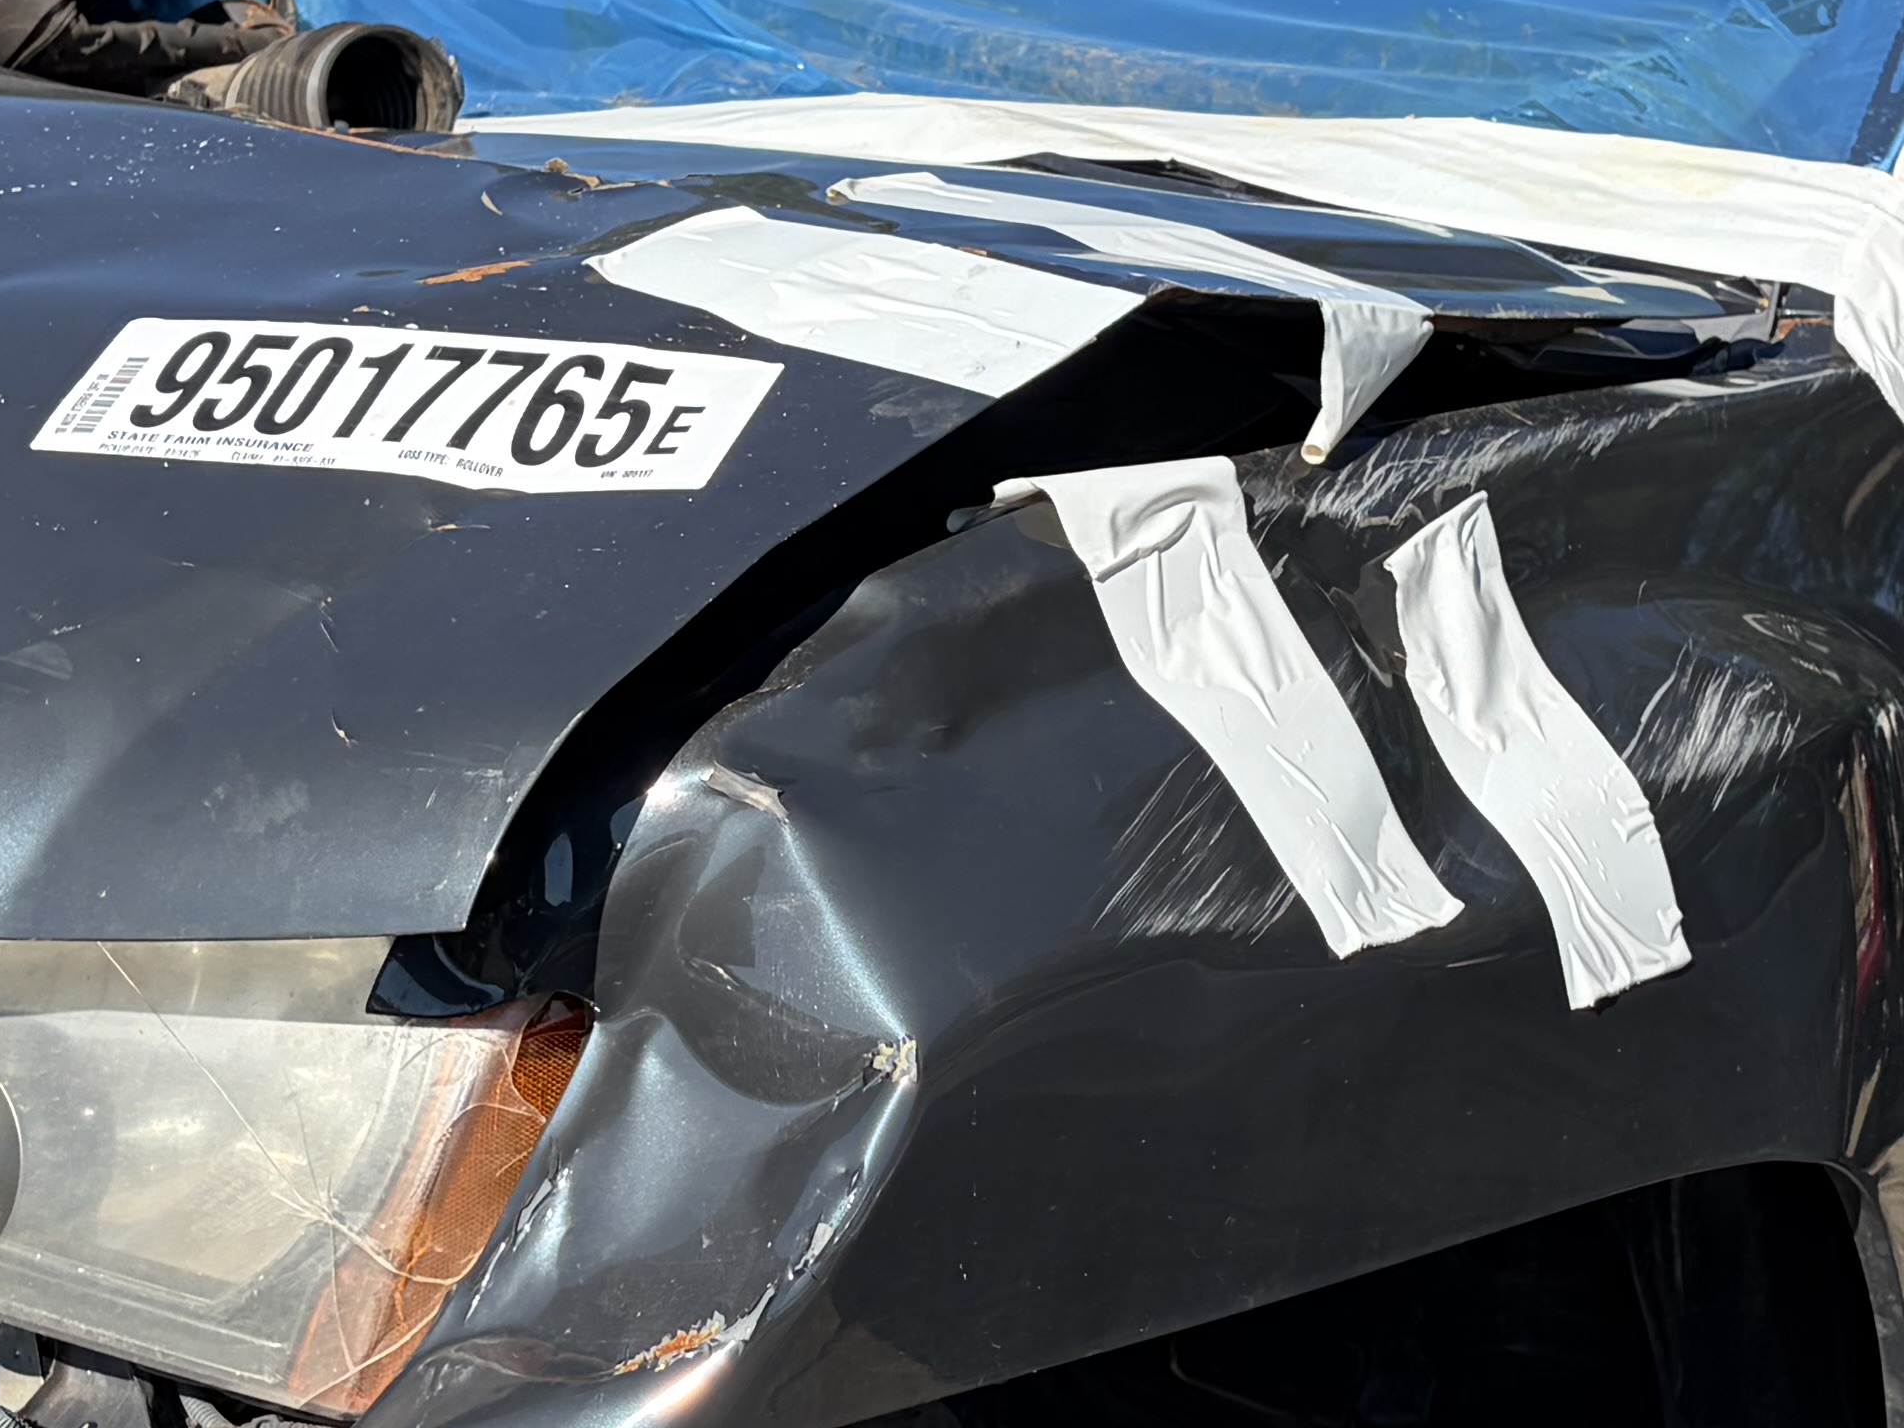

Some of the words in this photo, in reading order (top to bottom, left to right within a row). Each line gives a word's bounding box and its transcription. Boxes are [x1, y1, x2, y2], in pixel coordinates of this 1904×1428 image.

[108, 431, 159, 443] STATE
[163, 434, 212, 445] FARM
[216, 437, 314, 452] INSURANCE
[456, 458, 504, 478] ROLLOVER
